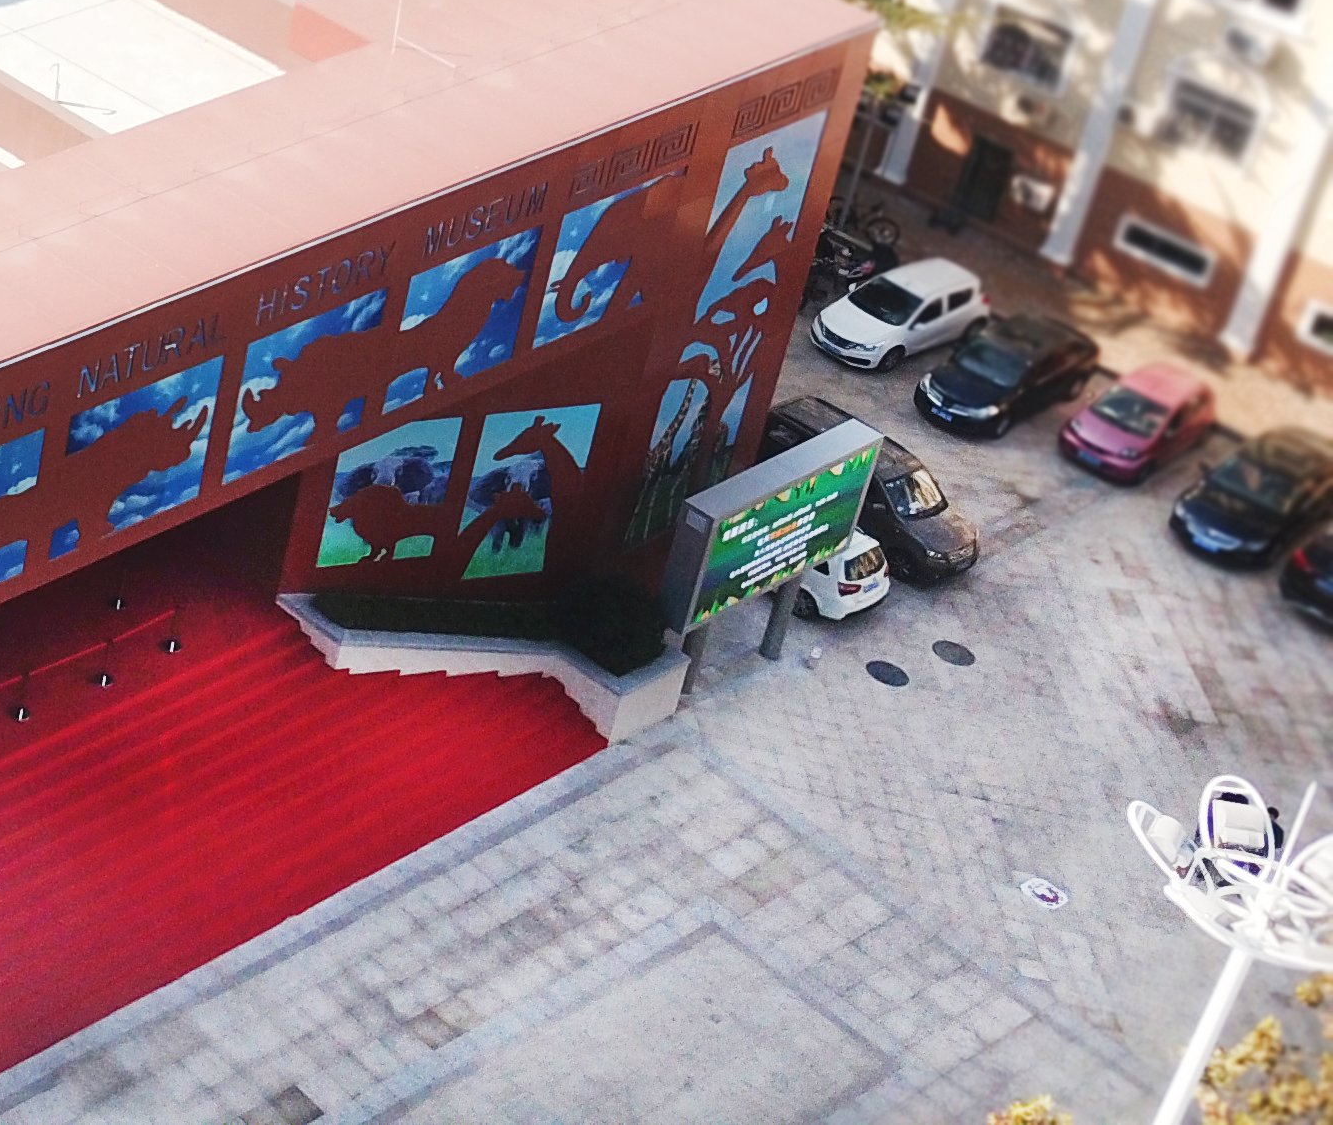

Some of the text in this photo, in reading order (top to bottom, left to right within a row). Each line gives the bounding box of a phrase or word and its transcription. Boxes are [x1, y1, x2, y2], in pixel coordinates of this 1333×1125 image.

[77, 313, 227, 398] NATURAL
[255, 241, 396, 326] HISTORY
[422, 181, 549, 258] MUSEUM
